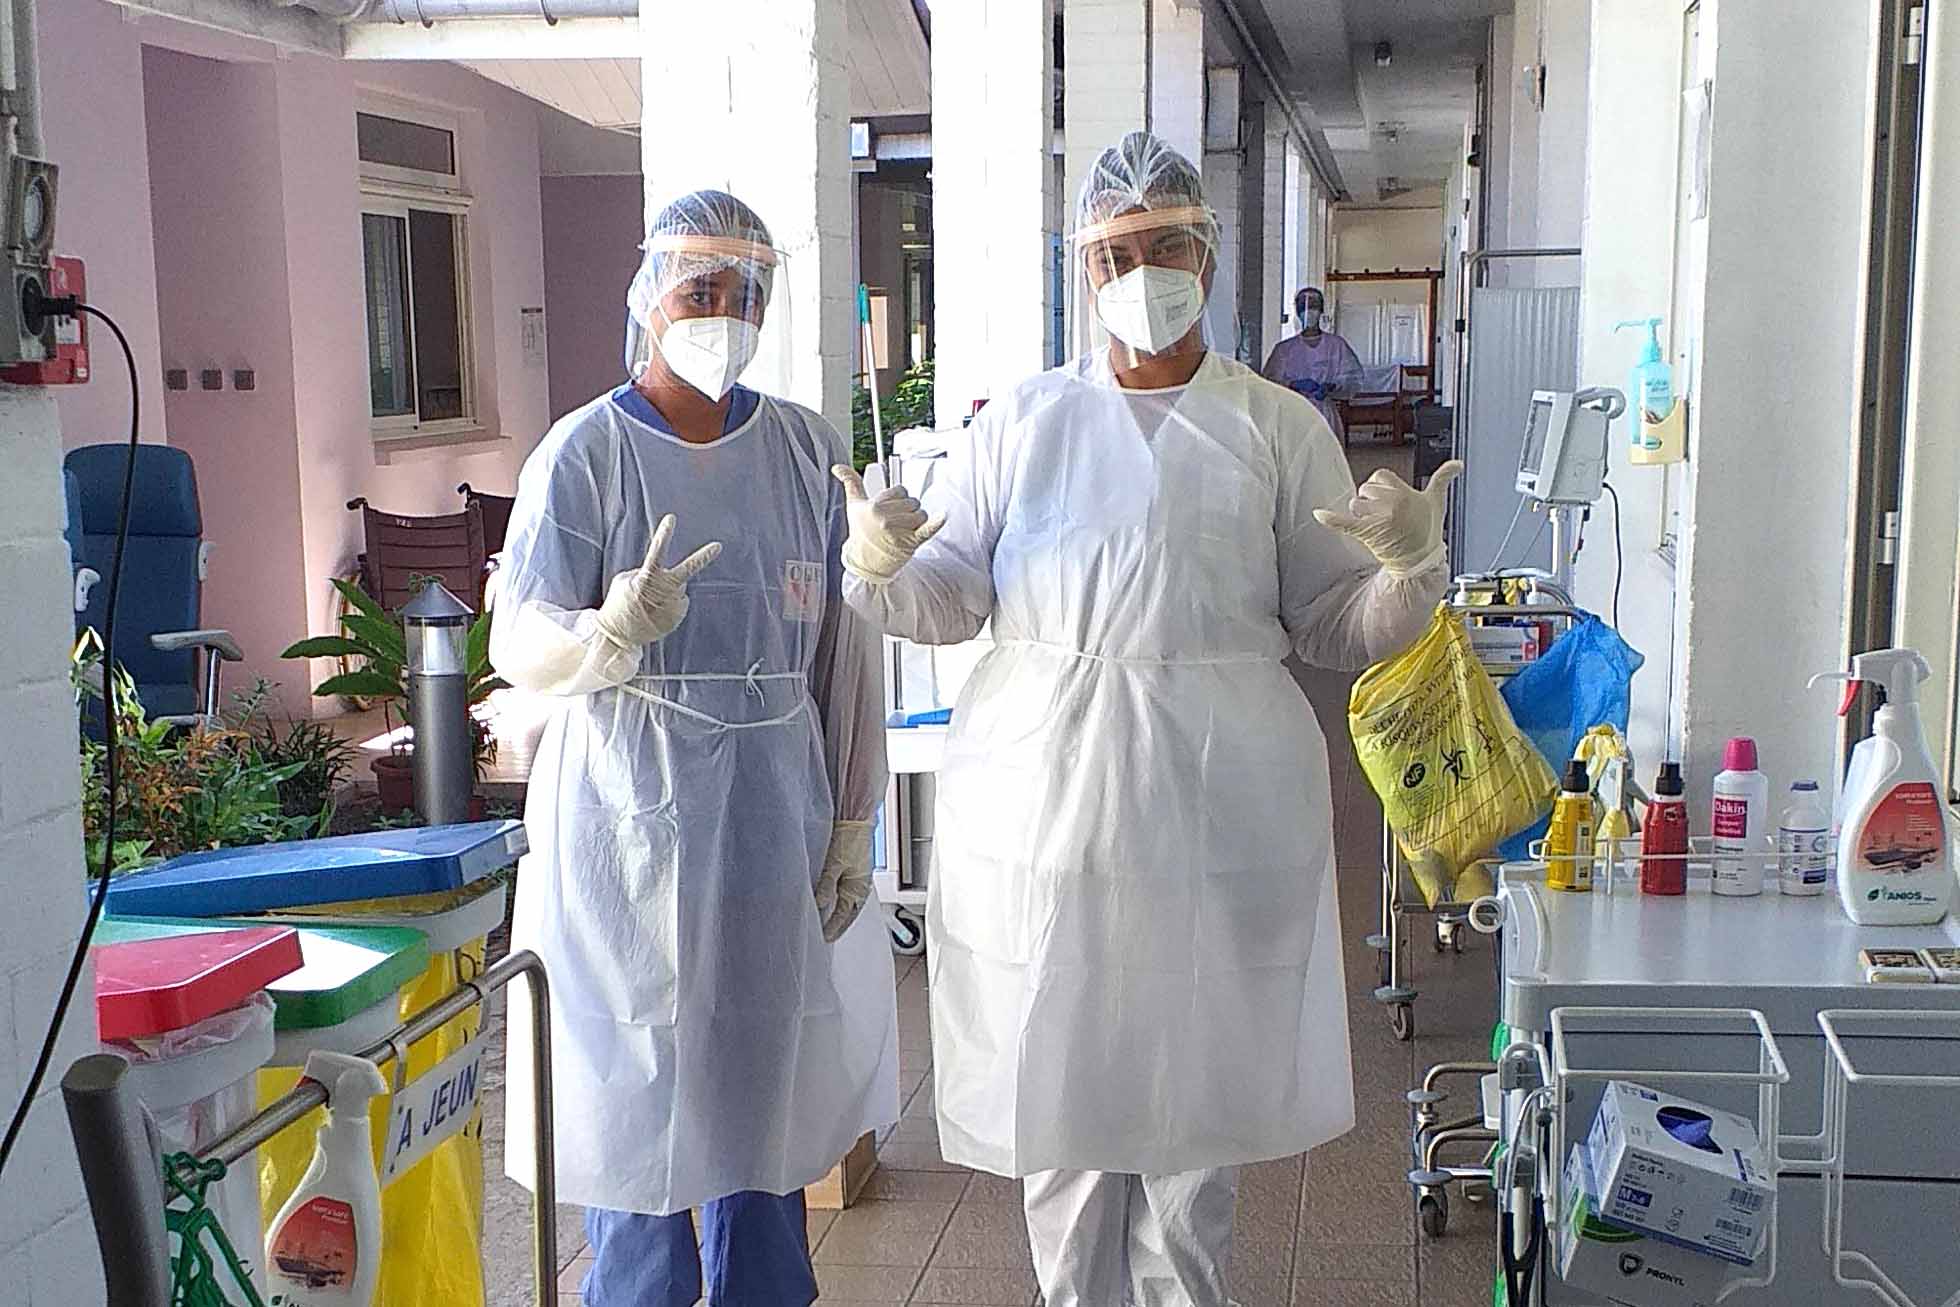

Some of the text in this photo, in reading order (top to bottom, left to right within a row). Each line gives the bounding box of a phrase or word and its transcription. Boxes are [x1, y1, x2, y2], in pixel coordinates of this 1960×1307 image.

[1405, 765, 1425, 786] NF
[1715, 800, 1745, 815] Dakin
[422, 1058, 479, 1136] JEUN
